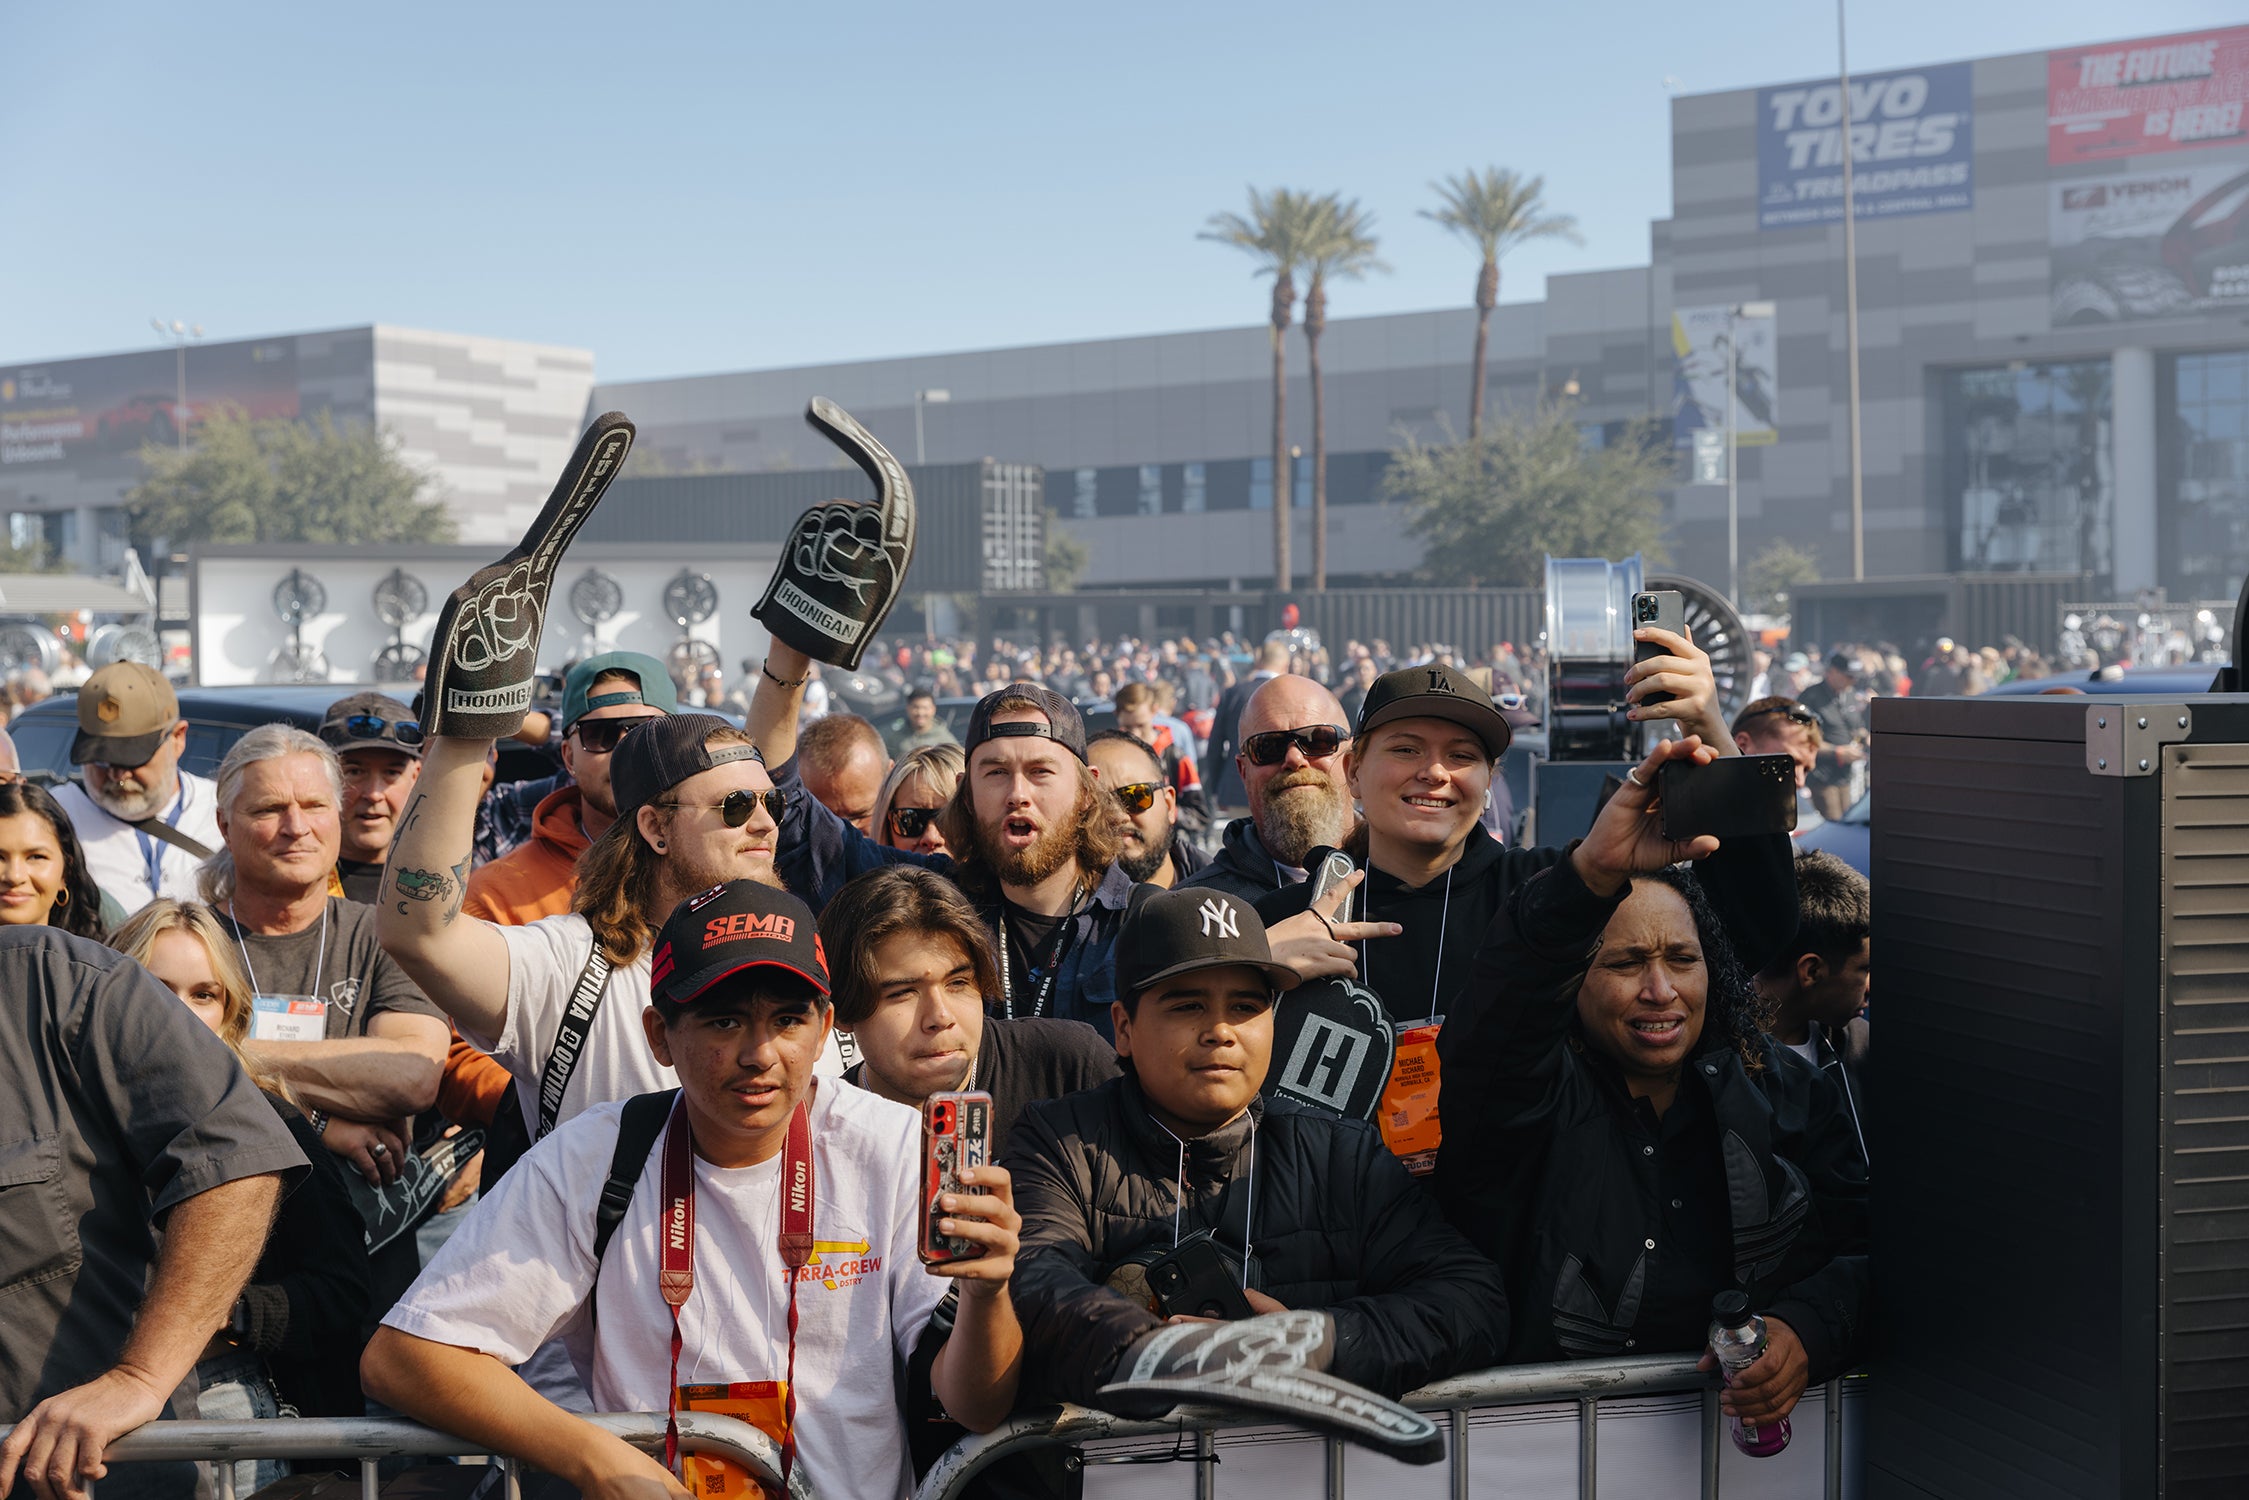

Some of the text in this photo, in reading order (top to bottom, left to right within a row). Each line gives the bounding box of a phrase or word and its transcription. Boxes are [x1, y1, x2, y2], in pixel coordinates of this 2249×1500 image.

[2123, 39, 2220, 85] FUTURE
[1769, 74, 1929, 131] TOYO
[1785, 112, 1959, 171] TIRES
[2111, 177, 2191, 198] VENOM
[574, 442, 621, 509] FULL
[1427, 669, 1456, 694] LA
[703, 913, 796, 941] SEMA
[749, 932, 791, 942] SHOW
[1199, 898, 1240, 938] NY
[569, 953, 609, 1022] OPTIMA
[543, 1047, 574, 1112] OPTIMA
[1399, 1056, 1425, 1067] MICHAEL
[1401, 1065, 1424, 1074] RICHARD
[791, 1160, 806, 1213] Nikon
[670, 1197, 686, 1251] Nikon
[781, 1257, 882, 1284] TRRA-CREW
[839, 1277, 863, 1288] DSTRY
